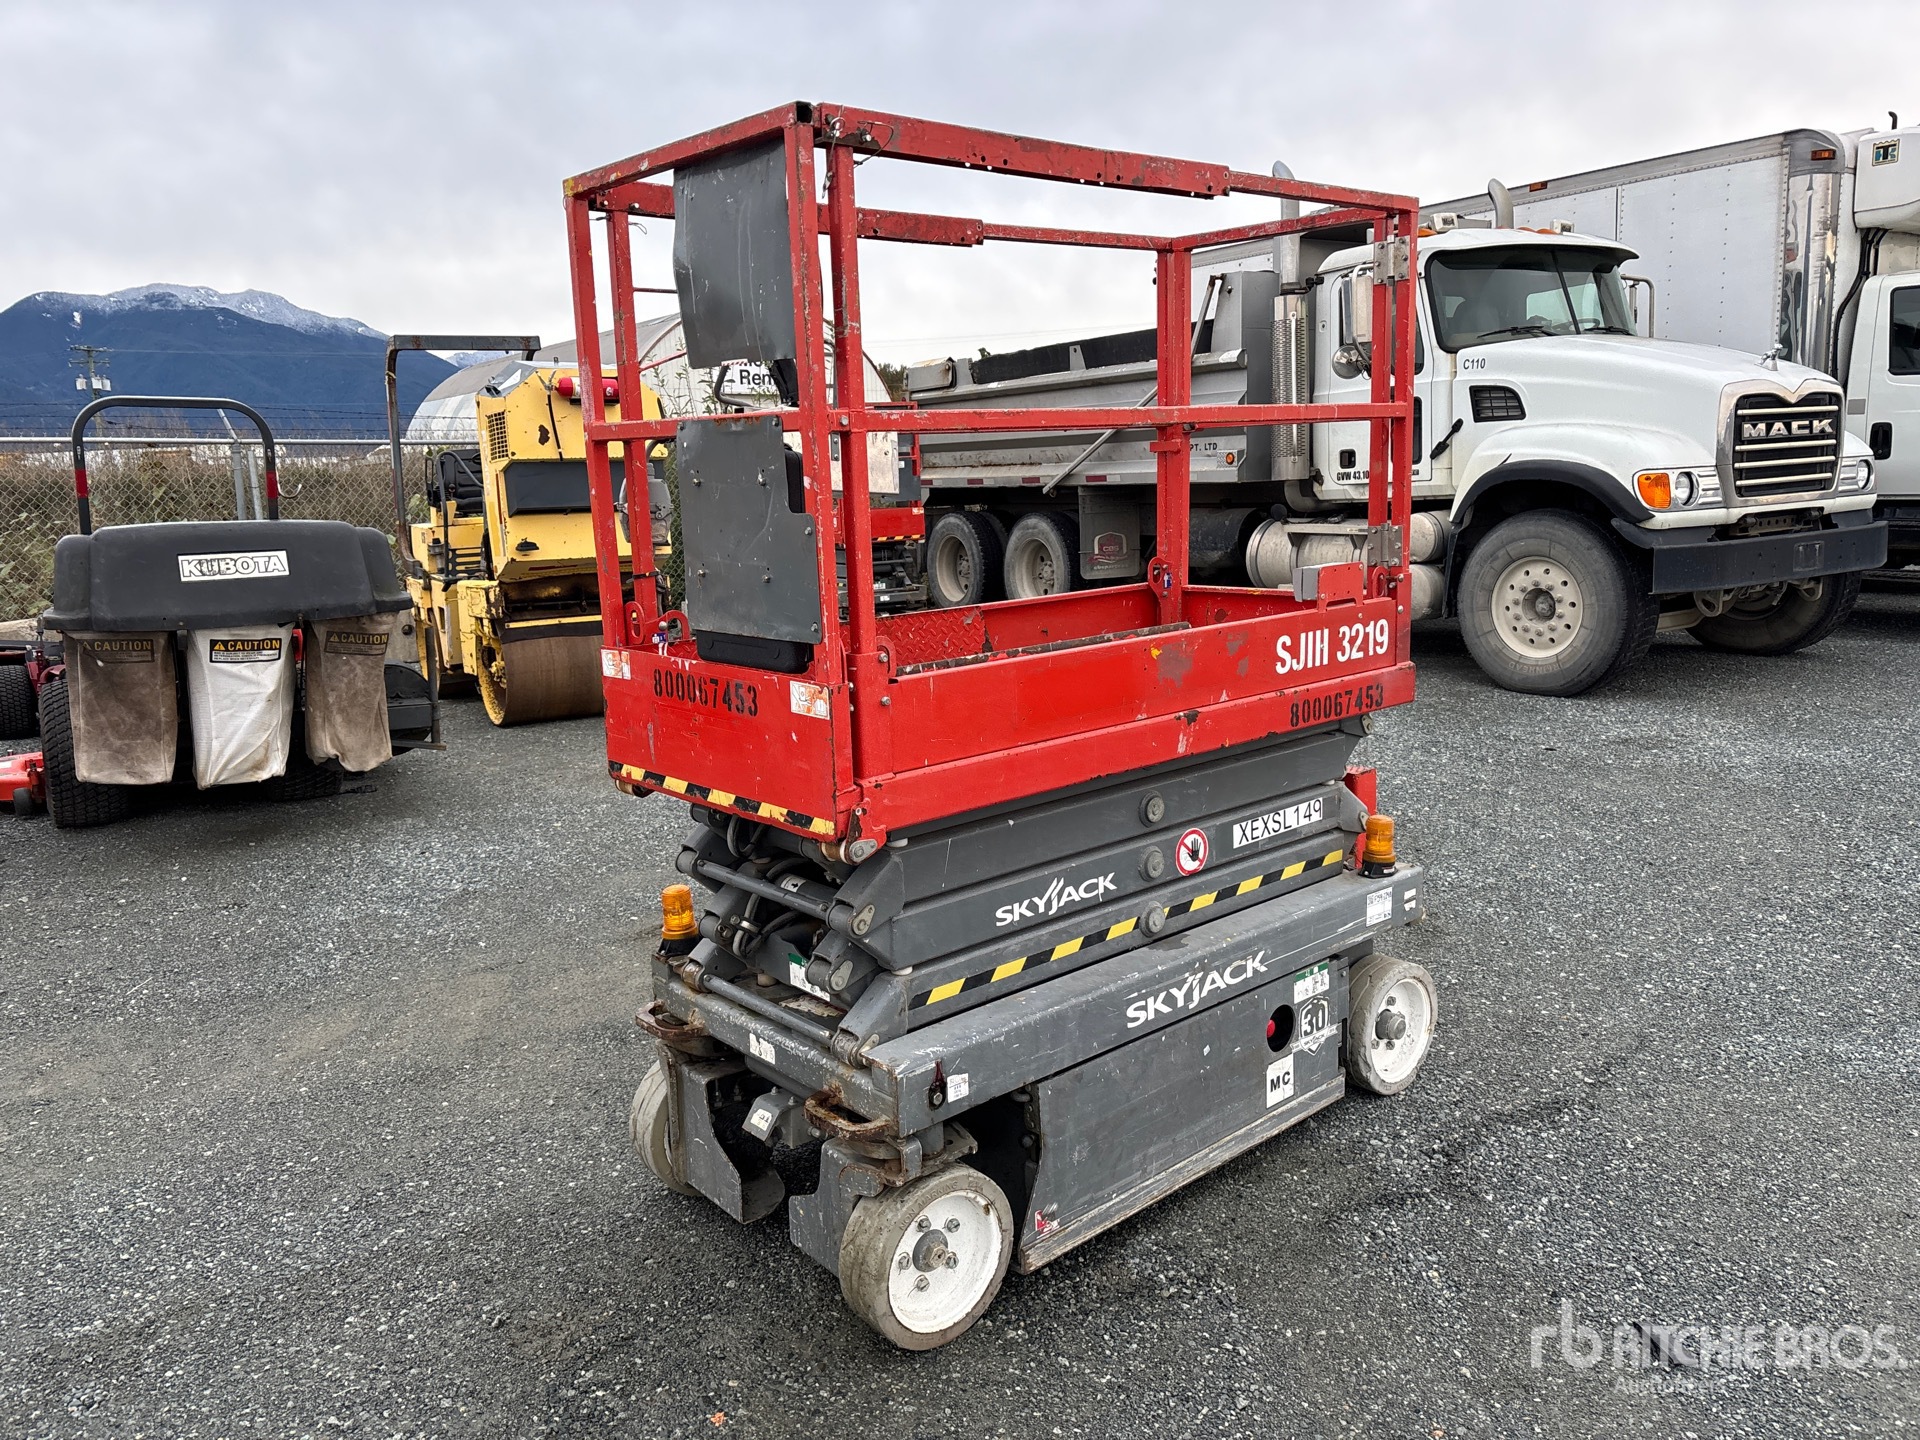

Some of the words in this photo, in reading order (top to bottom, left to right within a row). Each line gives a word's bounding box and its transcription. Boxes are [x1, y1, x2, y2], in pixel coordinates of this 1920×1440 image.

[1463, 358, 1486, 370] C110
[739, 369, 772, 385] Ren
[1743, 419, 1833, 438] MACK
[1204, 442, 1218, 451] LTD
[1336, 471, 1351, 481] GVW
[1352, 470, 1370, 480] 43,10
[180, 555, 286, 577] KUBOTA
[94, 640, 151, 651] CAUTION
[227, 639, 280, 651] CAUTION
[341, 633, 388, 644] CAUTION
[1336, 618, 1389, 662] 3219
[653, 668, 759, 717] 800067453
[1290, 683, 1384, 728] 800067453
[1238, 798, 1322, 845] XEXSL149
[995, 872, 1117, 927] SKYJACK
[1126, 950, 1268, 1029] SKYJACK
[1270, 1071, 1291, 1092] MC
